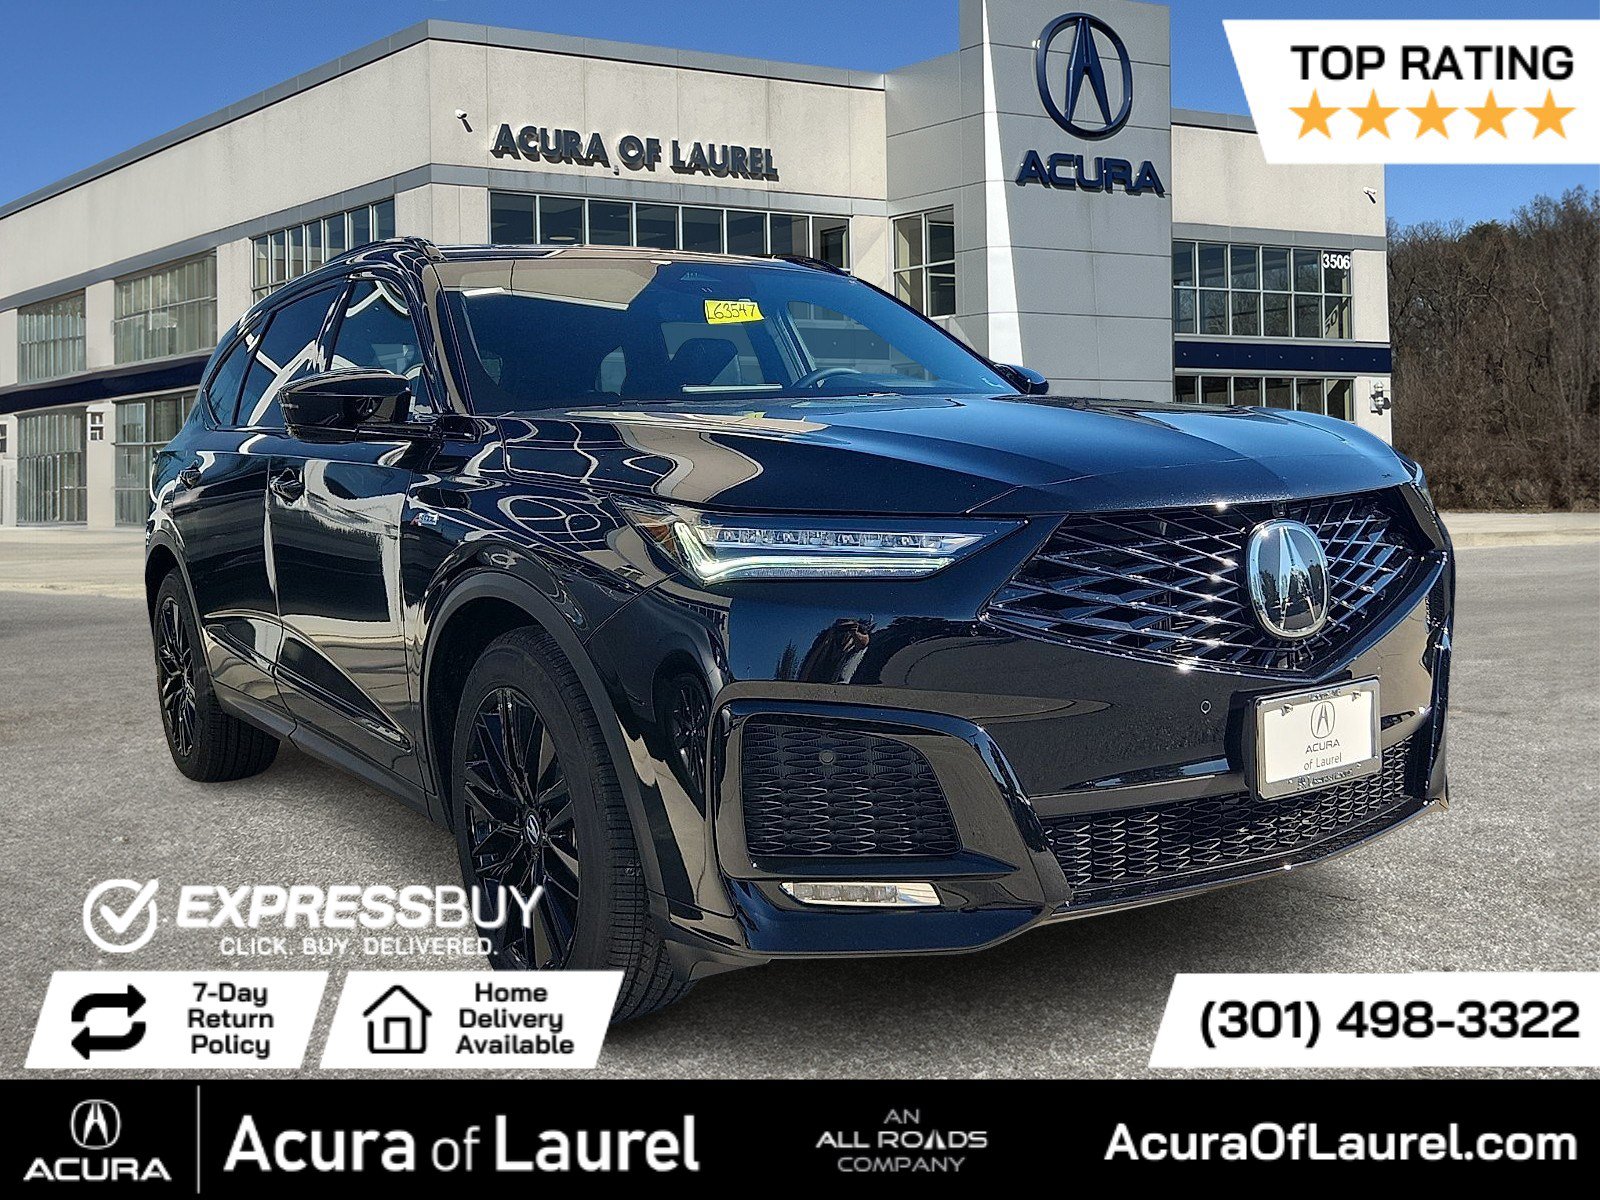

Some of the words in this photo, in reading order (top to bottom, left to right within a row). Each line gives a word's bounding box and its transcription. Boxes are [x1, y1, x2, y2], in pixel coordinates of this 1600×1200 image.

[490, 123, 610, 168] ACURA
[617, 135, 662, 172] OF
[670, 140, 779, 182] LAUREL
[1015, 149, 1166, 198] ACURA
[1322, 253, 1351, 270] 3506
[1305, 739, 1341, 754] ACURA
[1303, 760, 1314, 771] of
[1316, 752, 1342, 768] Laurel
